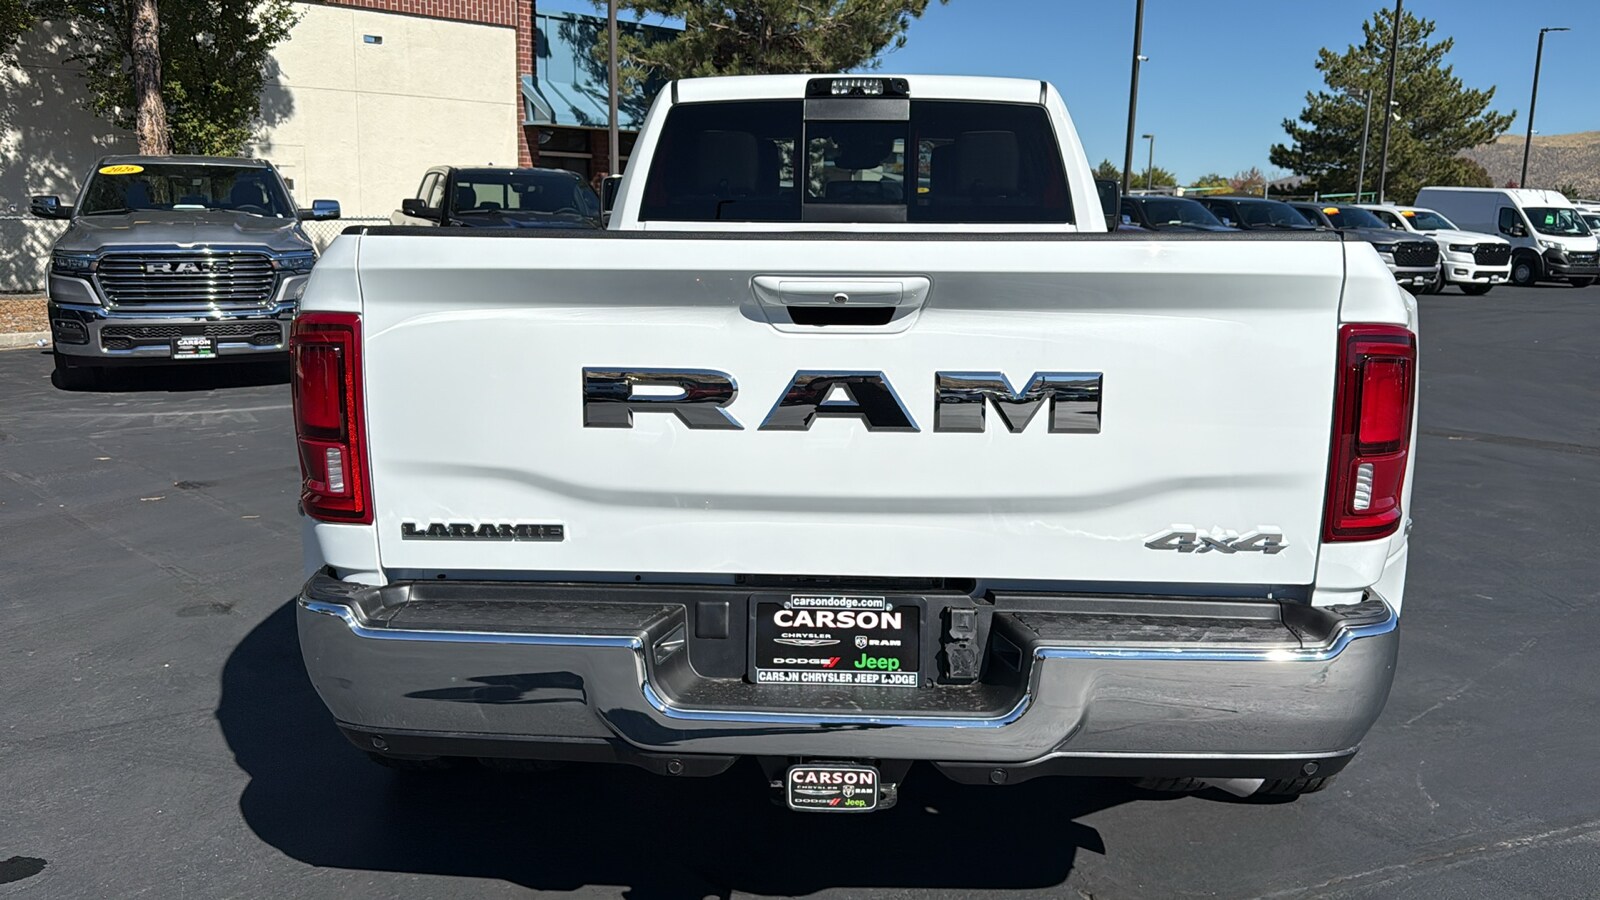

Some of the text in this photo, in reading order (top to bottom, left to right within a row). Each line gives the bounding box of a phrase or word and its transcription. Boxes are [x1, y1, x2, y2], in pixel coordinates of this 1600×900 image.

[107, 165, 135, 173] 2026
[582, 366, 1104, 434] RAM
[401, 522, 565, 542] LARAMIE
[793, 596, 883, 609] carsondodge.com
[773, 610, 902, 630] CARSON
[868, 639, 902, 647] RAM
[773, 657, 832, 665] DODGE
[854, 653, 900, 672] Jeep
[801, 672, 853, 683] CHRYSLER
[855, 673, 880, 684] JEEP
[792, 771, 873, 785] CARSON
[845, 798, 865, 807] Jeep
